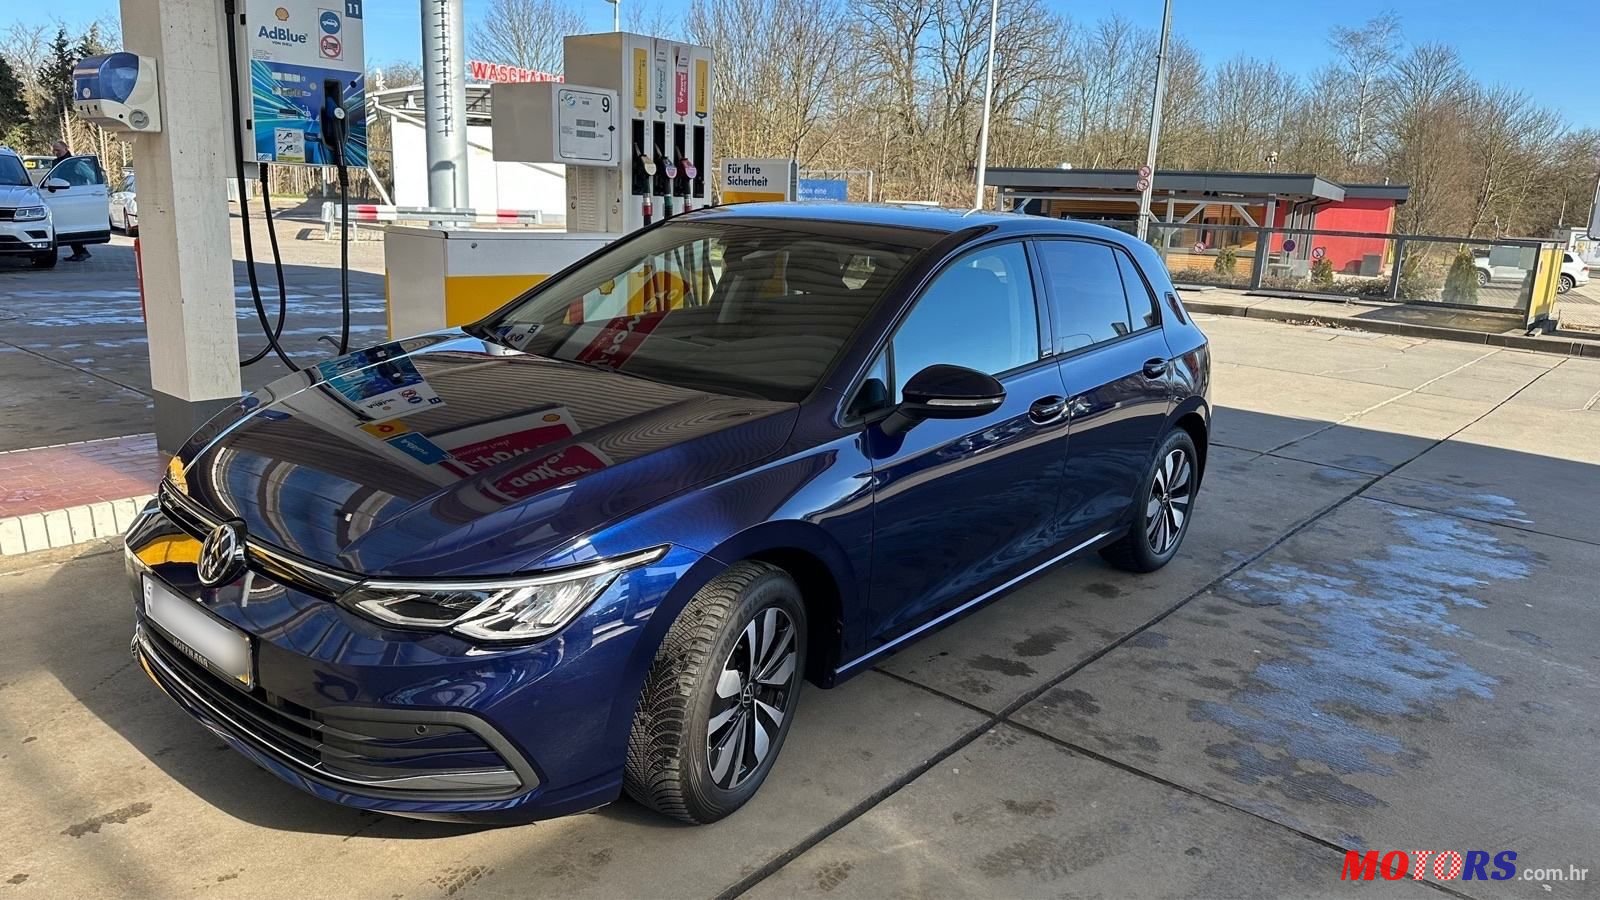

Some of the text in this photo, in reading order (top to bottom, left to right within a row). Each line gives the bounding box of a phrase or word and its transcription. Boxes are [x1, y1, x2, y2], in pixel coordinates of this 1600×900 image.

[347, 3, 360, 15] 11
[258, 25, 307, 44] AdBlue
[471, 61, 564, 83] WASCHAN
[602, 97, 610, 113] 9
[727, 164, 761, 175] Für Ihre
[727, 176, 768, 187] Sicherheit
